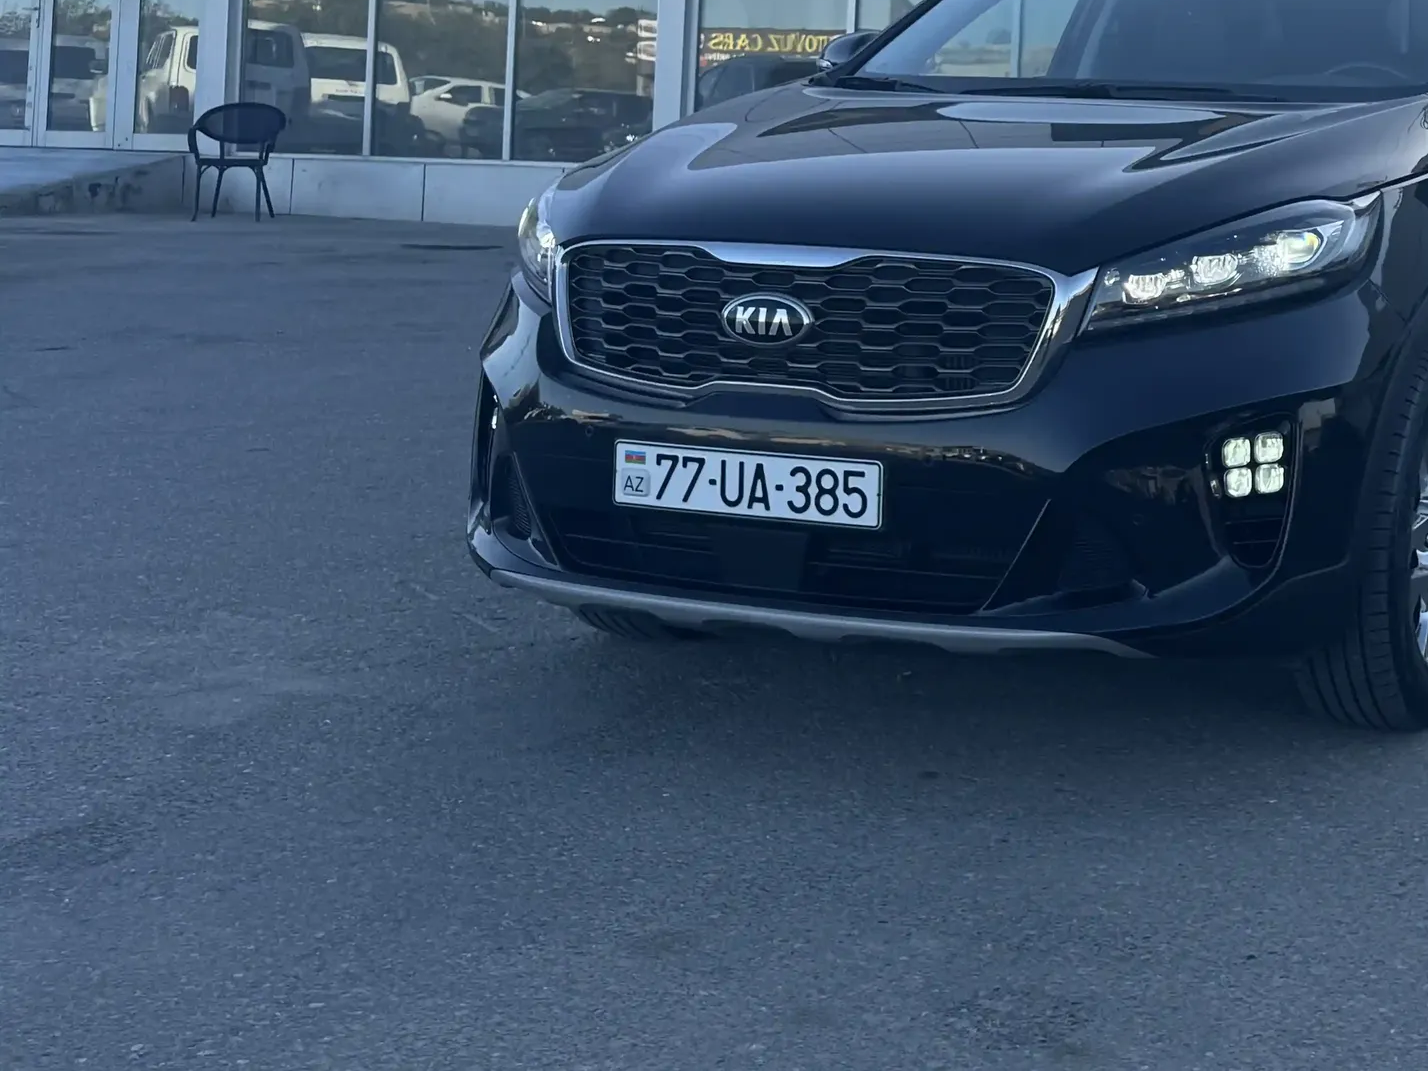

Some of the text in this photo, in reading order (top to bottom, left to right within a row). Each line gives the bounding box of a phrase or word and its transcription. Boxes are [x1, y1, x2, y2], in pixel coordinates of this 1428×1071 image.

[734, 305, 794, 337] KIA
[623, 452, 869, 519] AZ 77-UA-385
